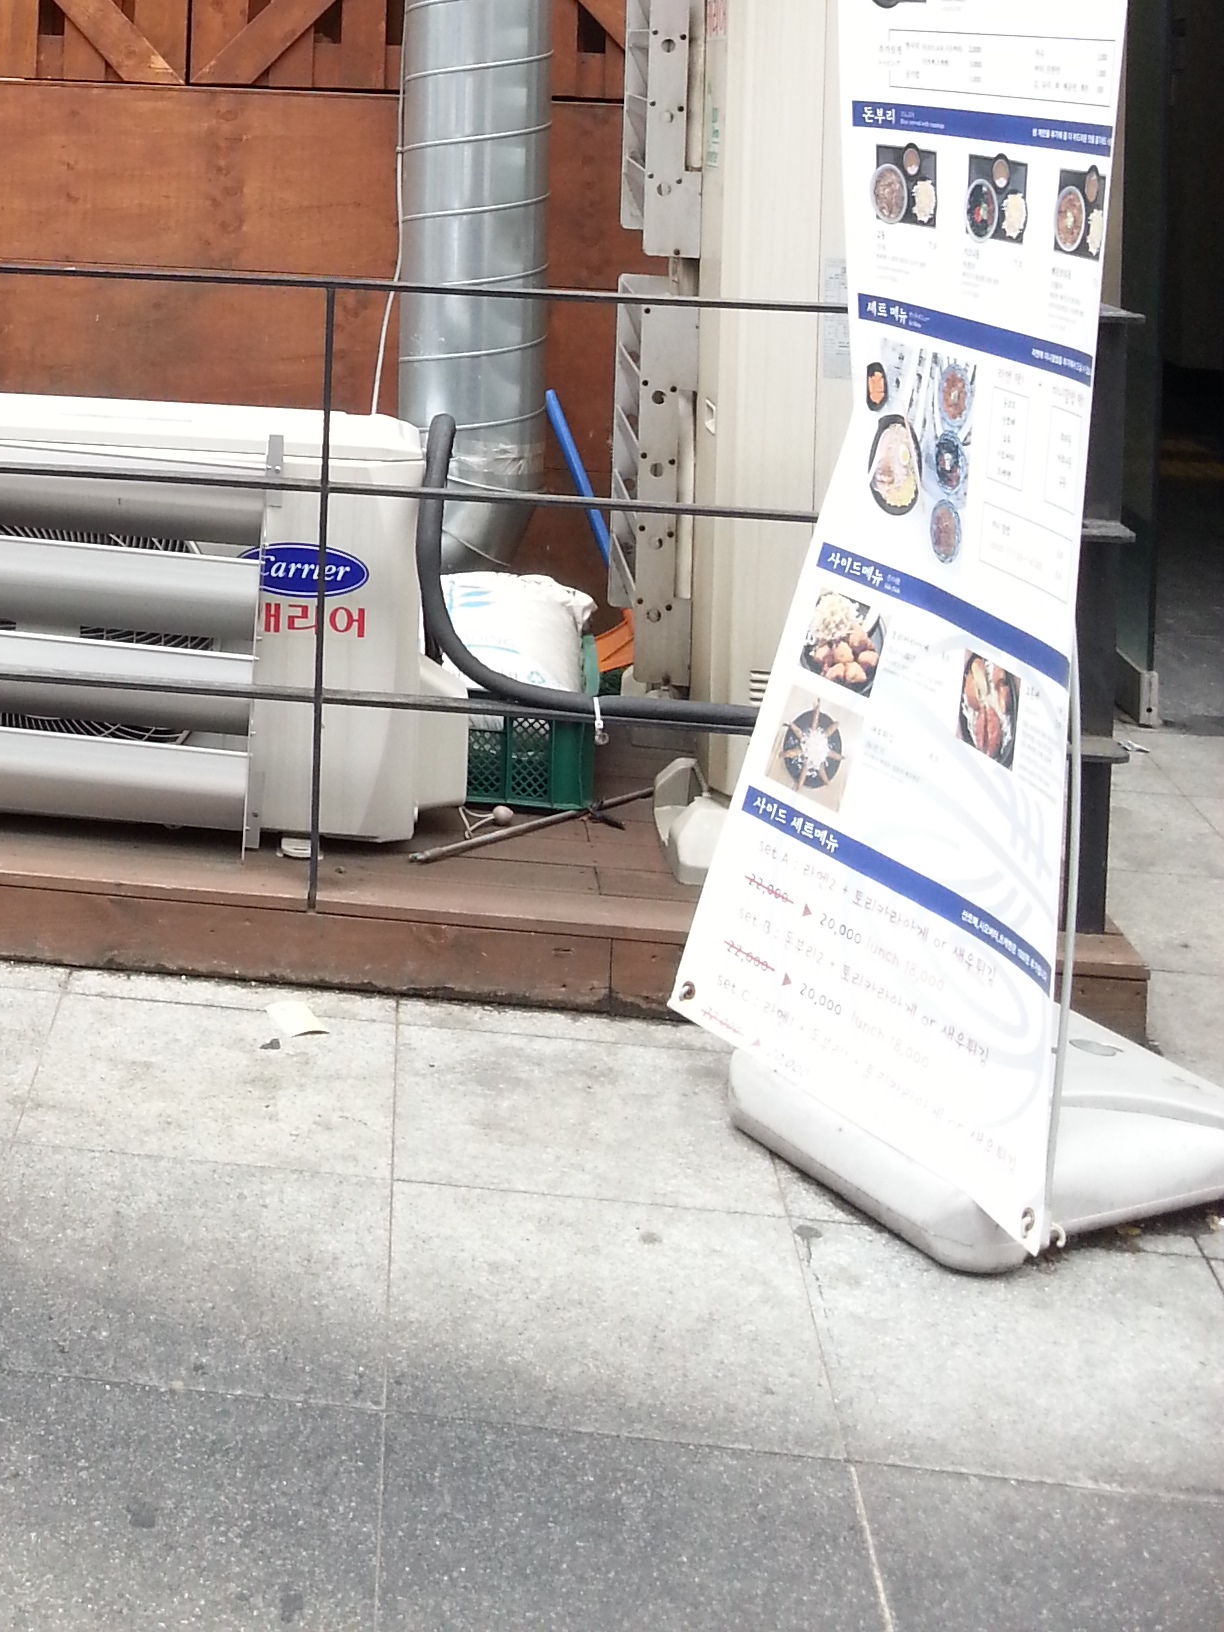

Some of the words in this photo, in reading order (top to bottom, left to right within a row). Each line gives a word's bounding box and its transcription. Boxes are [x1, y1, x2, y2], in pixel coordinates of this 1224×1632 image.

[862, 106, 896, 125] 돈부리
[753, 796, 787, 824] 사이드
[758, 839, 778, 861] set
[738, 906, 758, 929] set
[819, 912, 863, 946] 20,000
[865, 936, 901, 970] lunch
[799, 982, 844, 1017] 20,000
[850, 1009, 886, 1044] lunch
